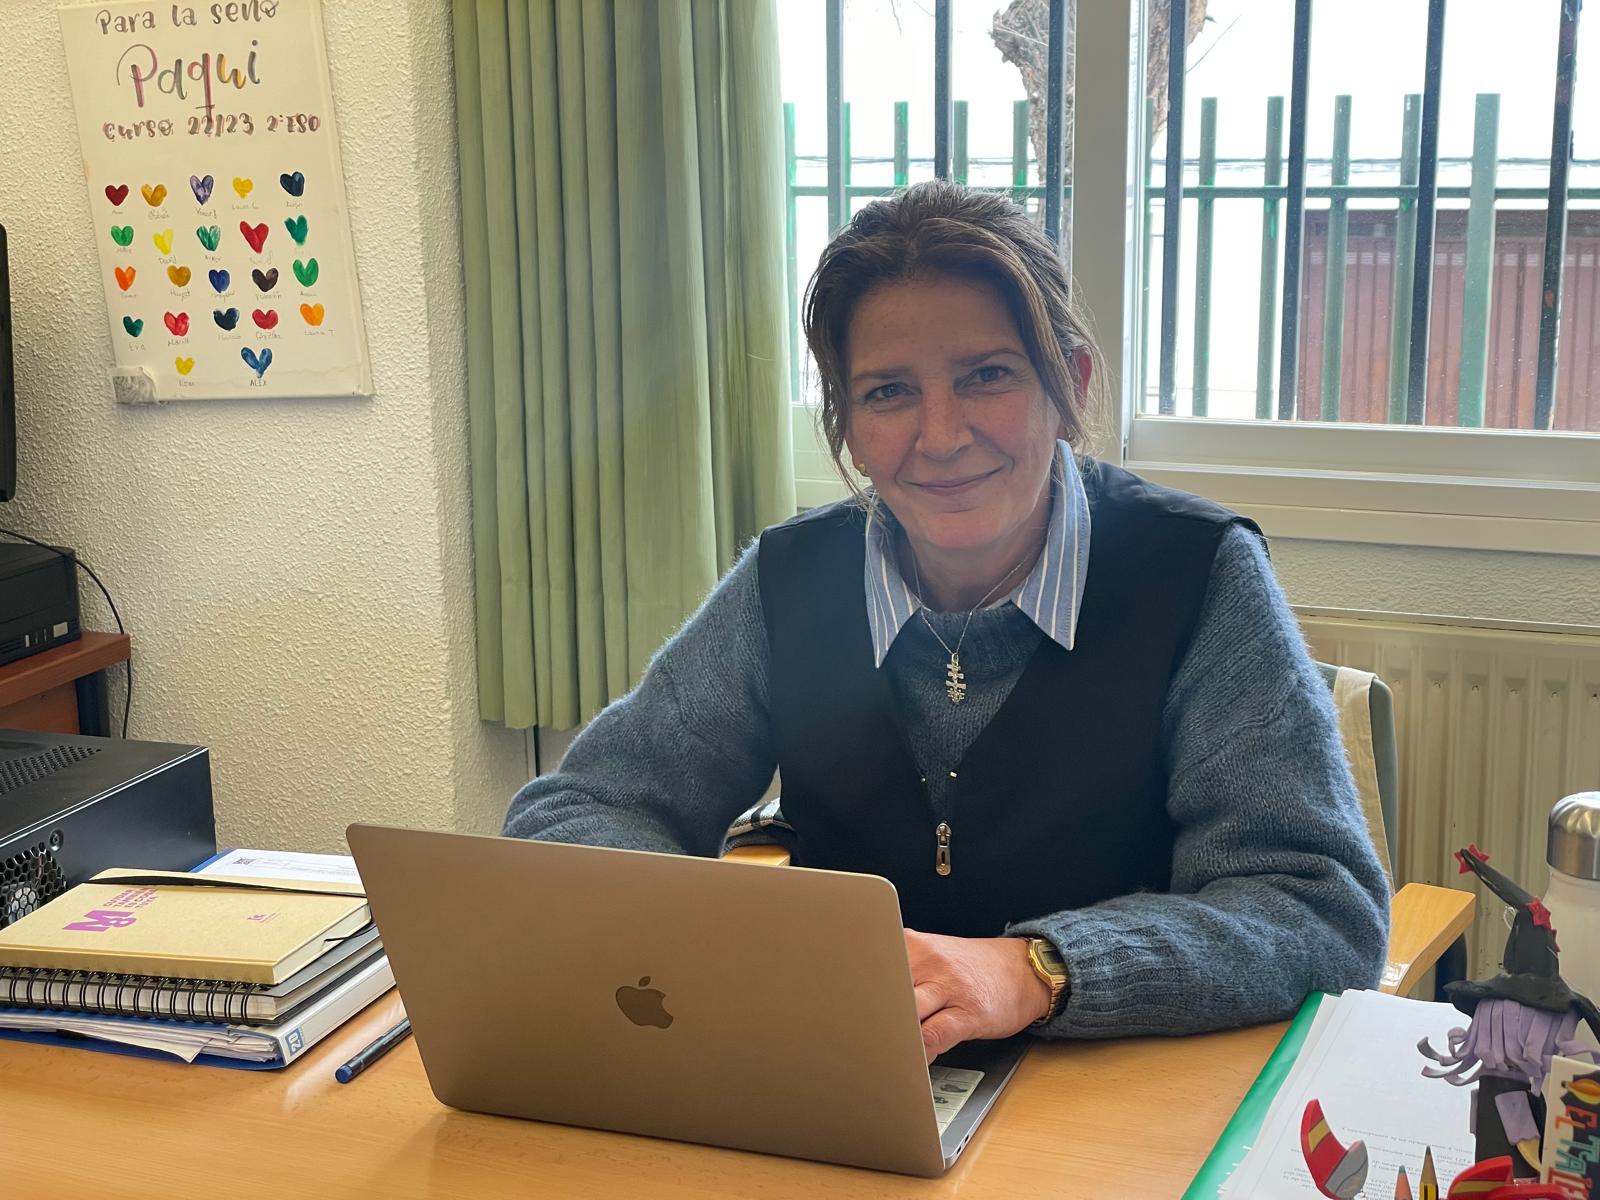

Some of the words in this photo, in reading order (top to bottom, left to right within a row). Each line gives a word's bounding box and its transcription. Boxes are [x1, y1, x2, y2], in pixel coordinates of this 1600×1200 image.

[95, 9, 157, 35] Para
[171, 4, 198, 27] la
[116, 39, 261, 126] Paqui
